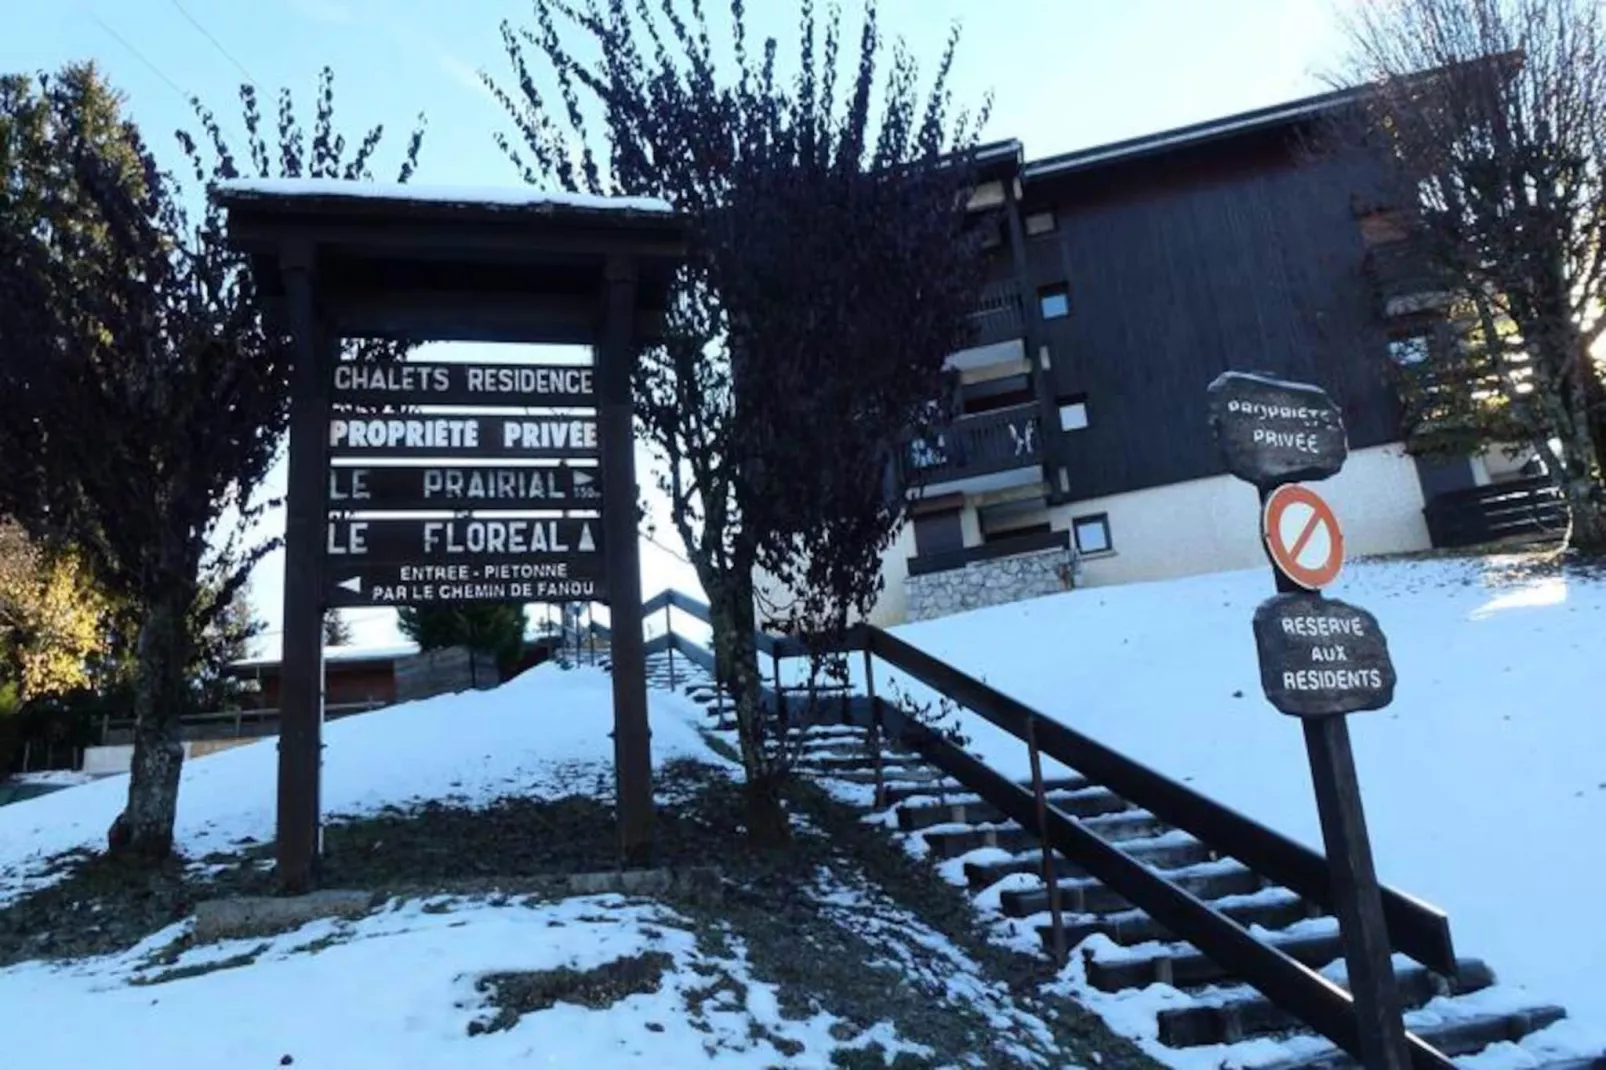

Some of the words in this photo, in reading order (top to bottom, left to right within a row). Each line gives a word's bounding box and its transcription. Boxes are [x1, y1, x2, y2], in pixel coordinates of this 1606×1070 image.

[334, 366, 450, 392] CHALETS
[468, 368, 594, 394] RESIDENCE
[330, 470, 371, 500] LE
[423, 470, 566, 499] PRAIRIAL
[328, 522, 369, 554] LE
[424, 521, 569, 553] FLOREAL
[400, 565, 469, 581] ENTREE
[484, 563, 568, 580] PIETONNE
[373, 586, 407, 601] PAR
[412, 585, 433, 599] LE
[439, 583, 505, 599] CHEMIN
[511, 582, 533, 597] DE
[537, 581, 594, 597] FANOU
[1281, 616, 1364, 637] RESERVE
[1311, 644, 1347, 662] AUX
[1283, 668, 1382, 690] RESIDENTS
